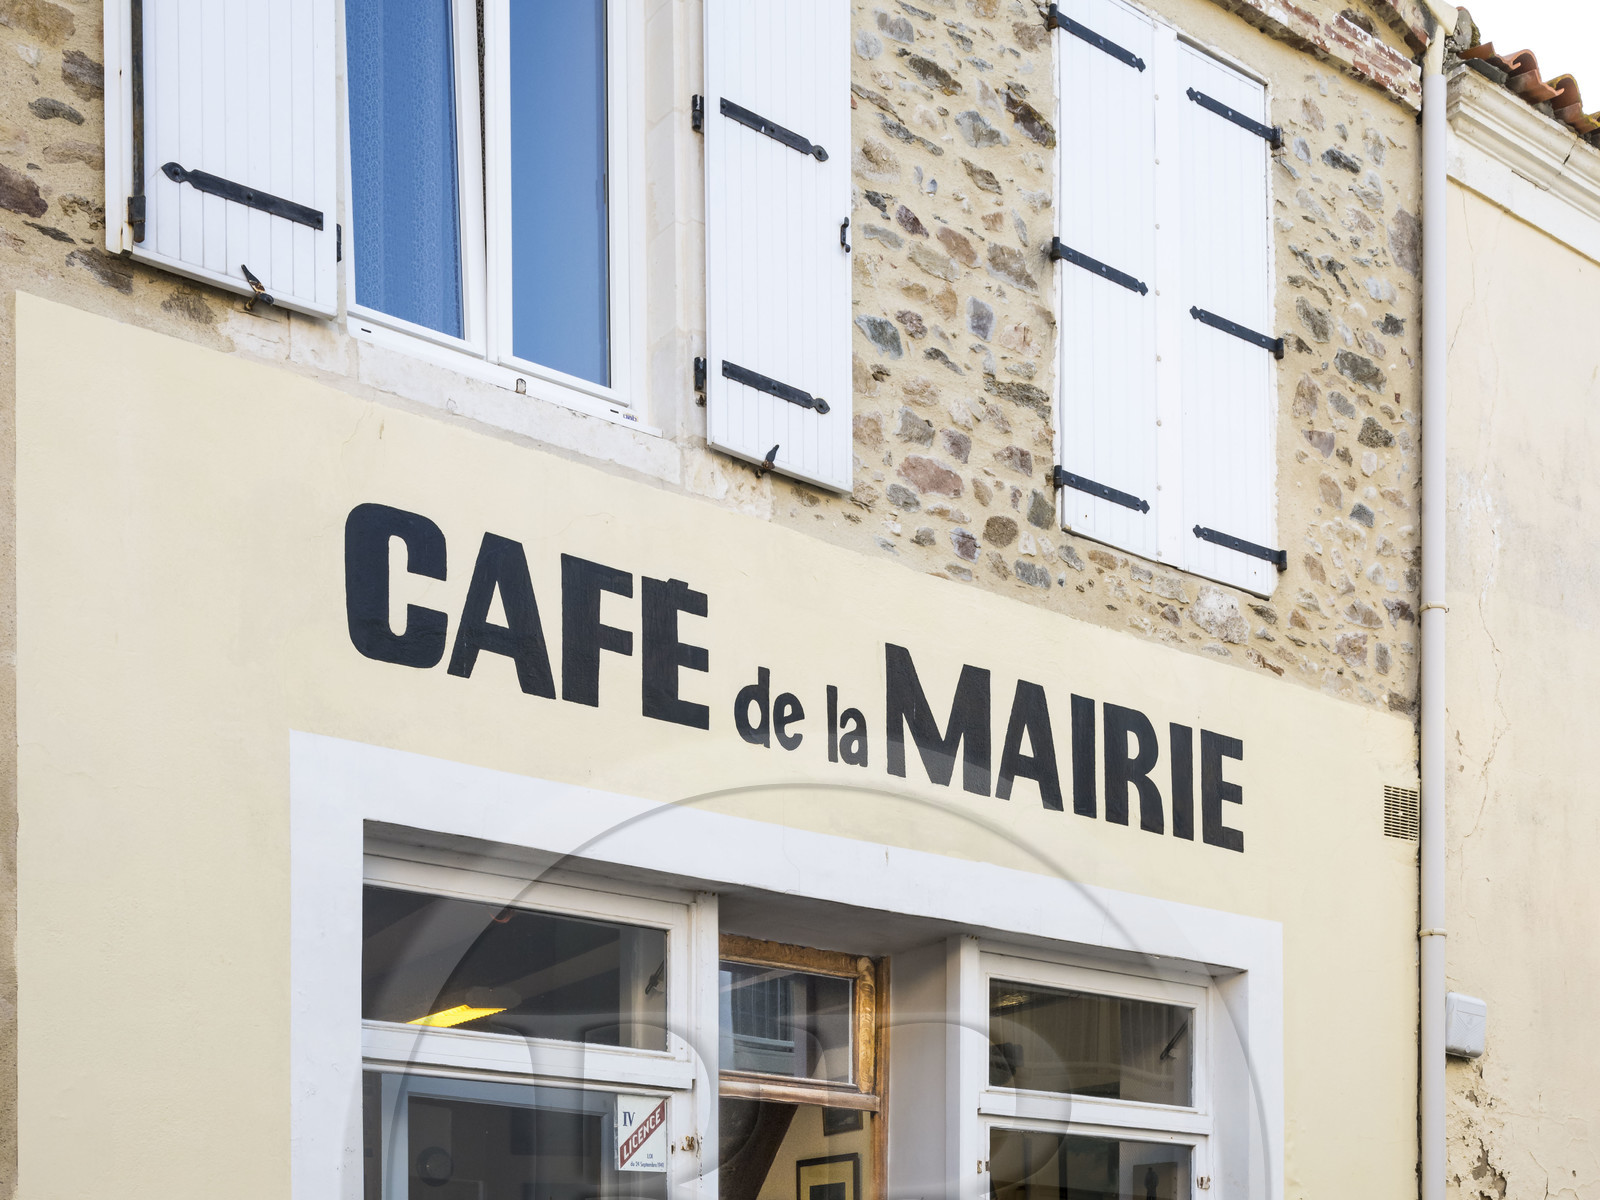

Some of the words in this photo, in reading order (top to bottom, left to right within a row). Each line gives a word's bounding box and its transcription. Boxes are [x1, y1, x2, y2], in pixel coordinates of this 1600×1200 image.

[735, 667, 804, 751] de
[827, 685, 868, 767] la
[886, 643, 1243, 853] MAIRIE
[623, 1112, 635, 1126] IV
[623, 1108, 661, 1160] LICENCE
